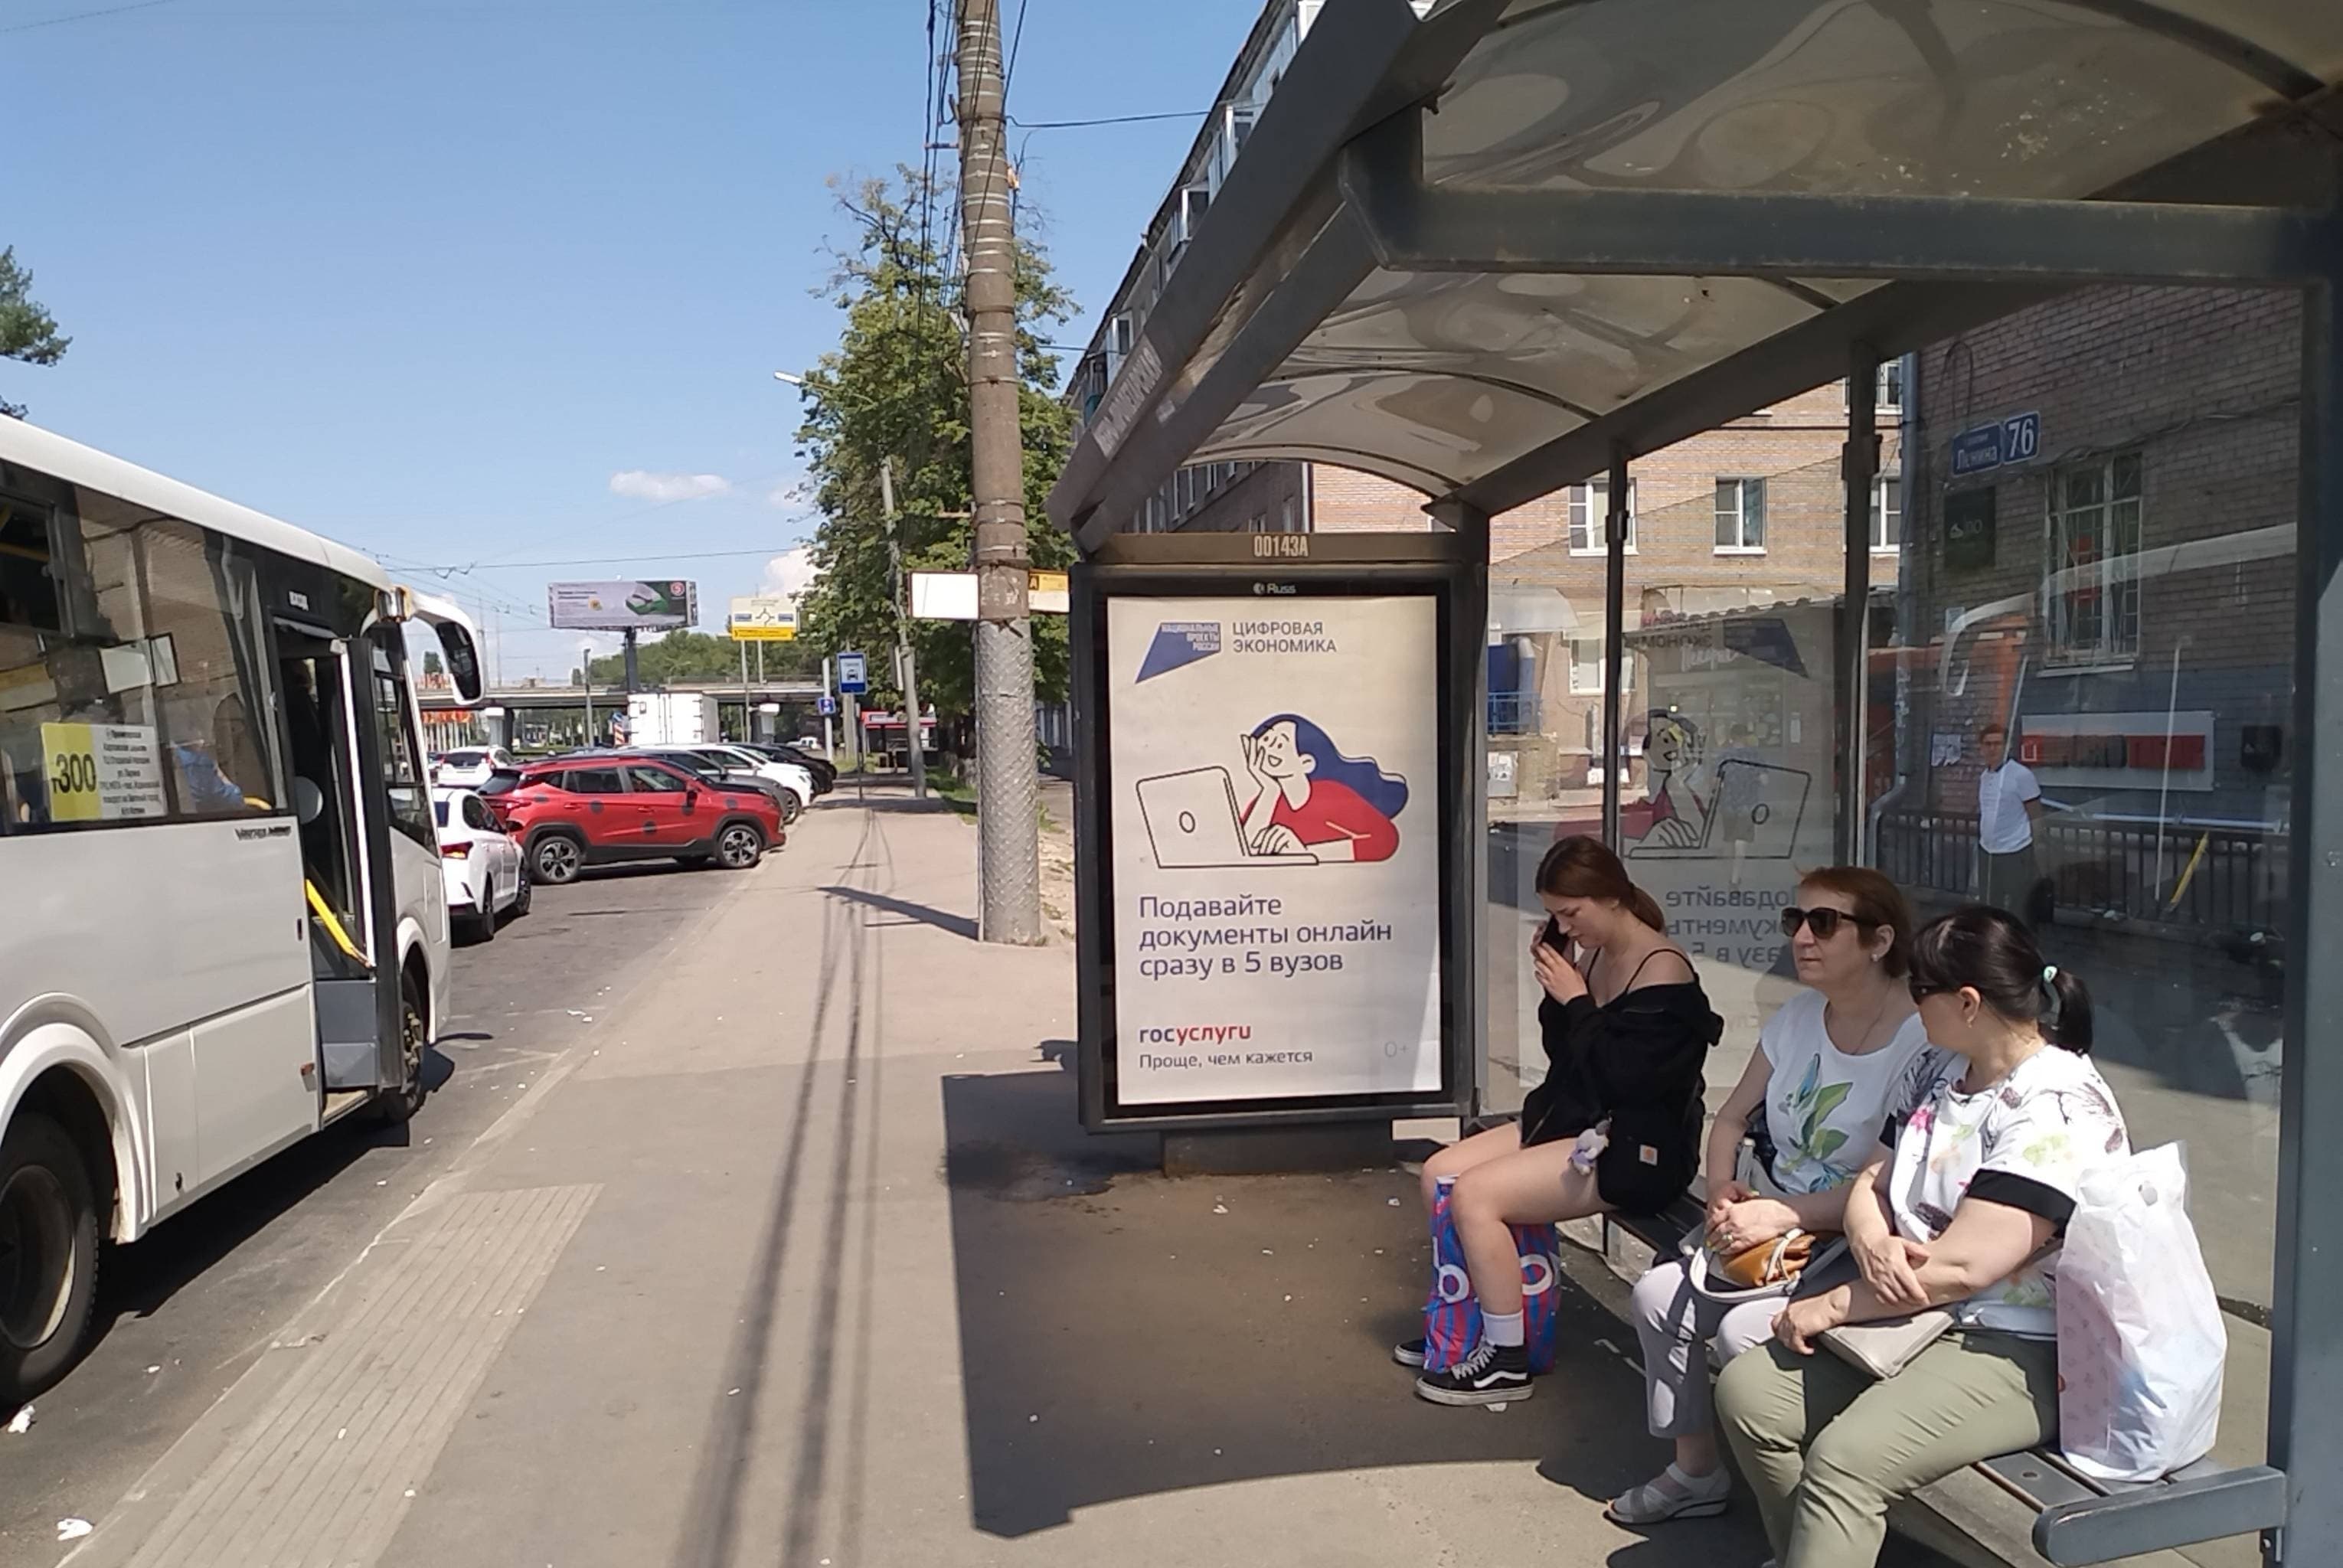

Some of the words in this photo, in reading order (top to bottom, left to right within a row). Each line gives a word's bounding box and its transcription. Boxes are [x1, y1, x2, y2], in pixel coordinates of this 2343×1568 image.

[2008, 418, 2034, 458] 76
[1254, 535, 1309, 557] 00143A
[1267, 583, 1296, 594] Russ
[1233, 622, 1323, 636] ЦИФРОВАЯ
[1233, 639, 1338, 653] ЭКОНОМИКА
[1139, 894, 1282, 920] Подавайте
[1139, 925, 1288, 952] документы
[1296, 920, 1392, 942] онлайн
[1139, 956, 1214, 980] сразу
[1222, 956, 1236, 973] в
[1245, 951, 1261, 972] 5
[1270, 953, 1344, 978] вузов
[1139, 1024, 1252, 1046] госуслуги
[1139, 1054, 1203, 1069] Проще,
[1208, 1053, 1240, 1066] чем
[1246, 1050, 1313, 1064] кажется
[1384, 1041, 1410, 1058] 0+
